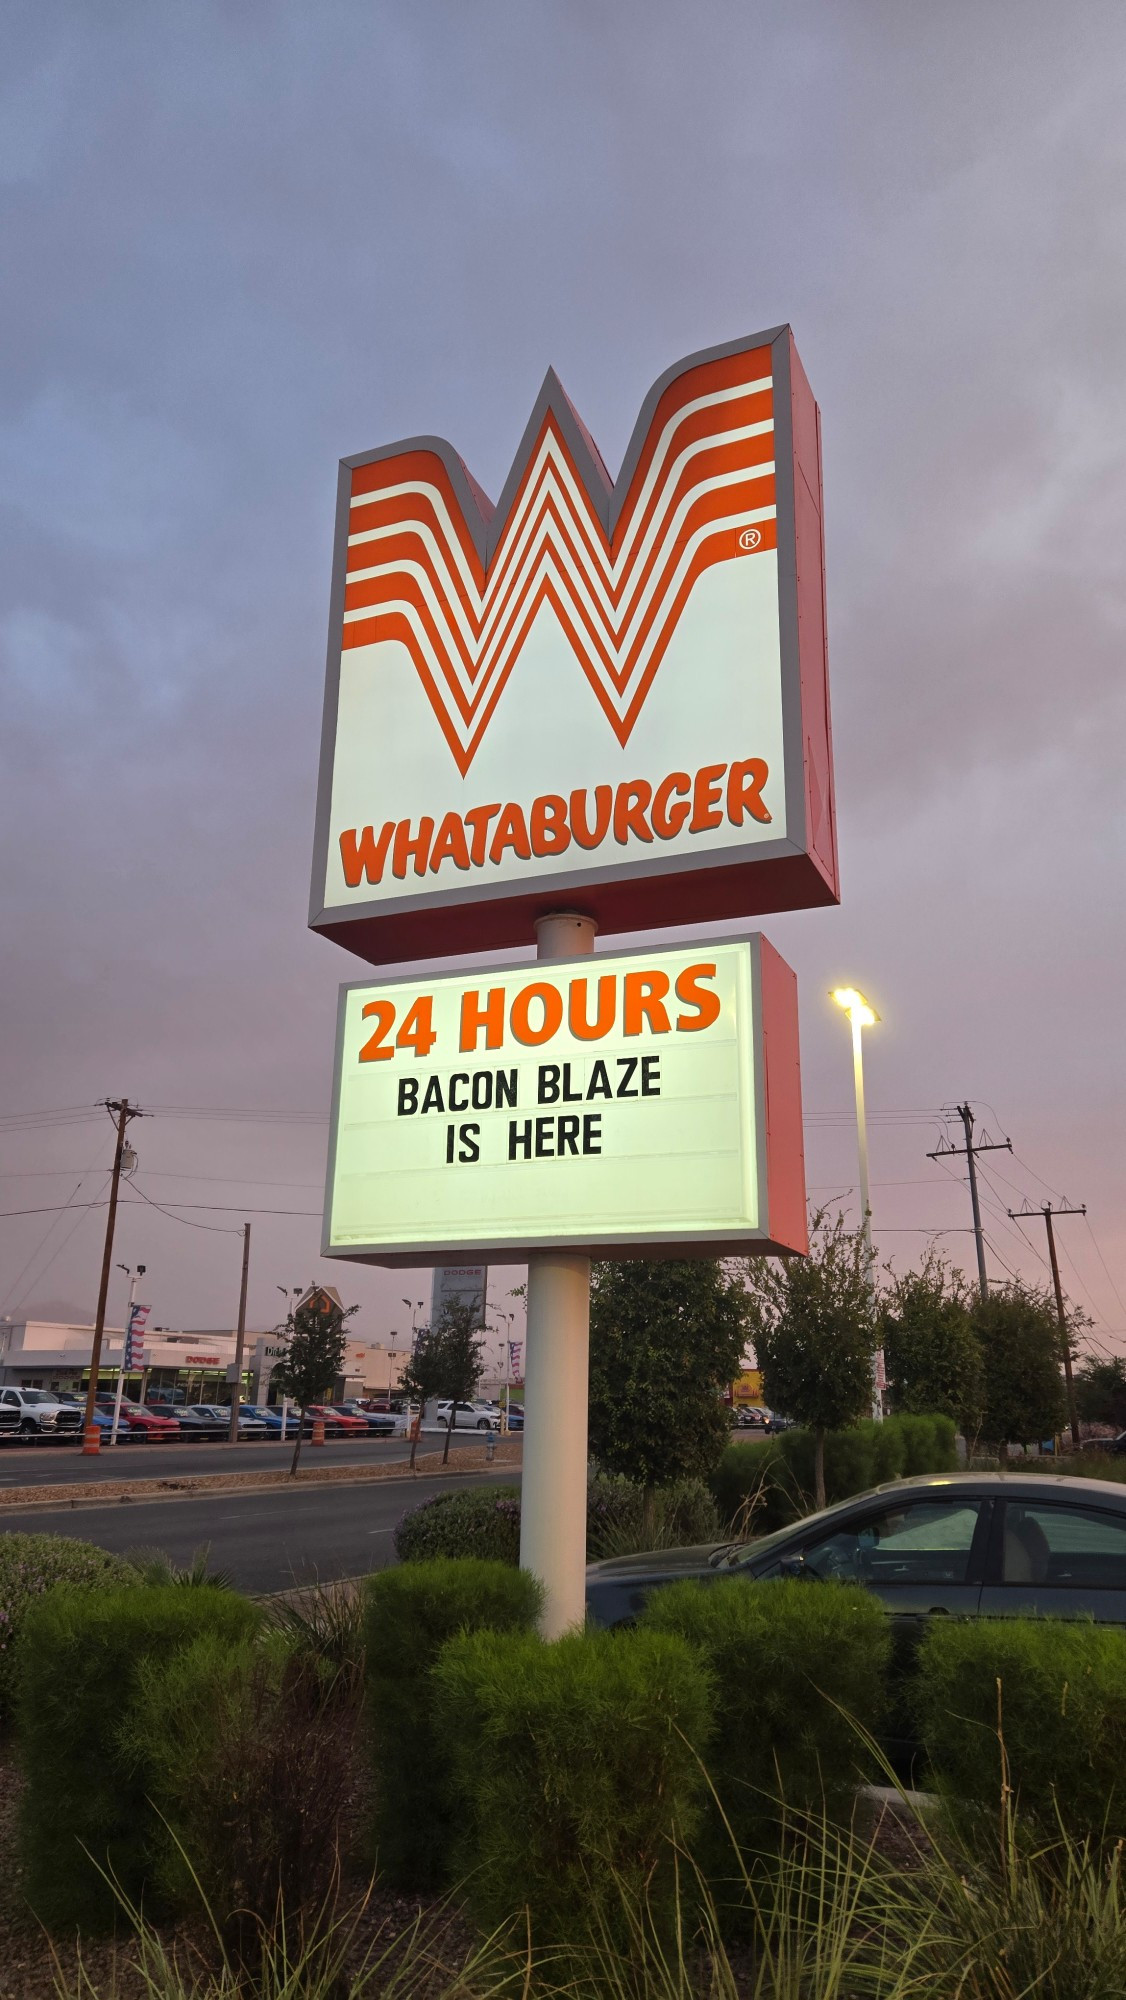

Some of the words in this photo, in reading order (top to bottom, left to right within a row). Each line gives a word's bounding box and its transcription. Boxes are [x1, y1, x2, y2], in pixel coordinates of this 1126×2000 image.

[339, 758, 772, 888] WHATABURGER
[359, 996, 437, 1062] 24
[460, 964, 722, 1051] HOURS
[397, 1069, 518, 1117] BACON
[537, 1056, 661, 1105] BLAZE
[446, 1123, 481, 1164] IS
[508, 1114, 602, 1161] HERE
[185, 1355, 220, 1365] DODGE
